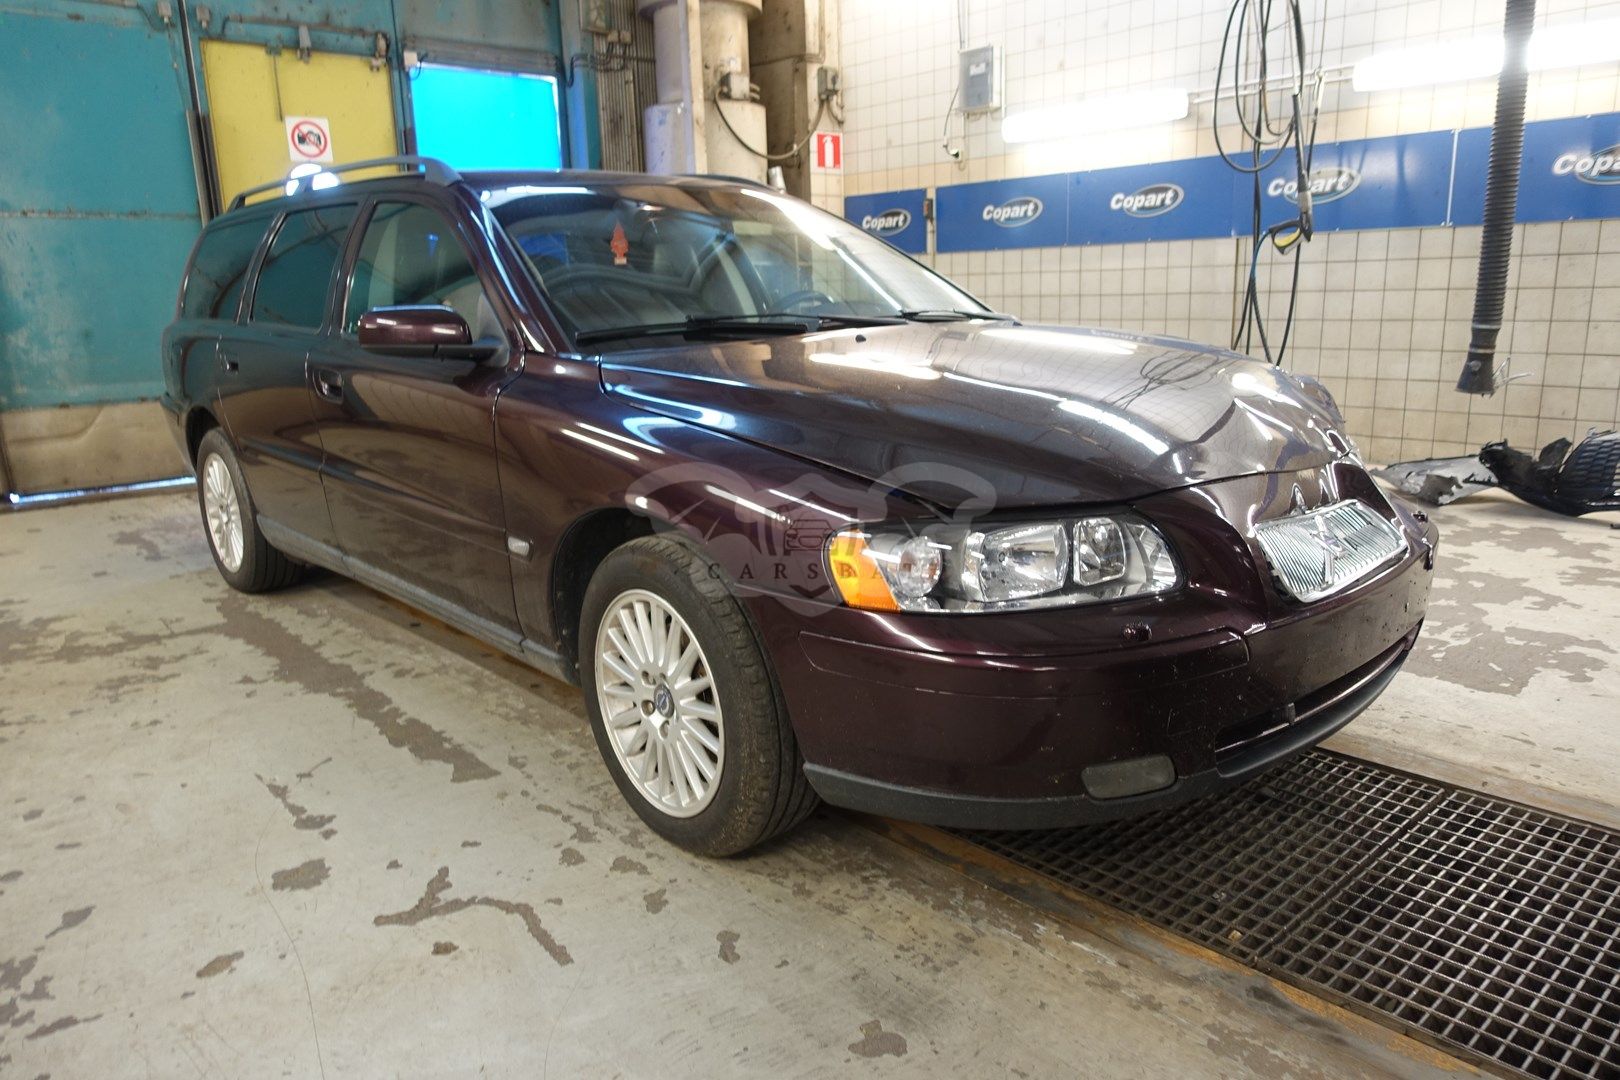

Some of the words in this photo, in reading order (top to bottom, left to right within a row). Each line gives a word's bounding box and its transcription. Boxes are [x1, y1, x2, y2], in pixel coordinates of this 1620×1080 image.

[1267, 174, 1349, 199] Coart
[982, 201, 1035, 222] Copart
[1110, 189, 1175, 212] Copart
[862, 212, 905, 231] Copart
